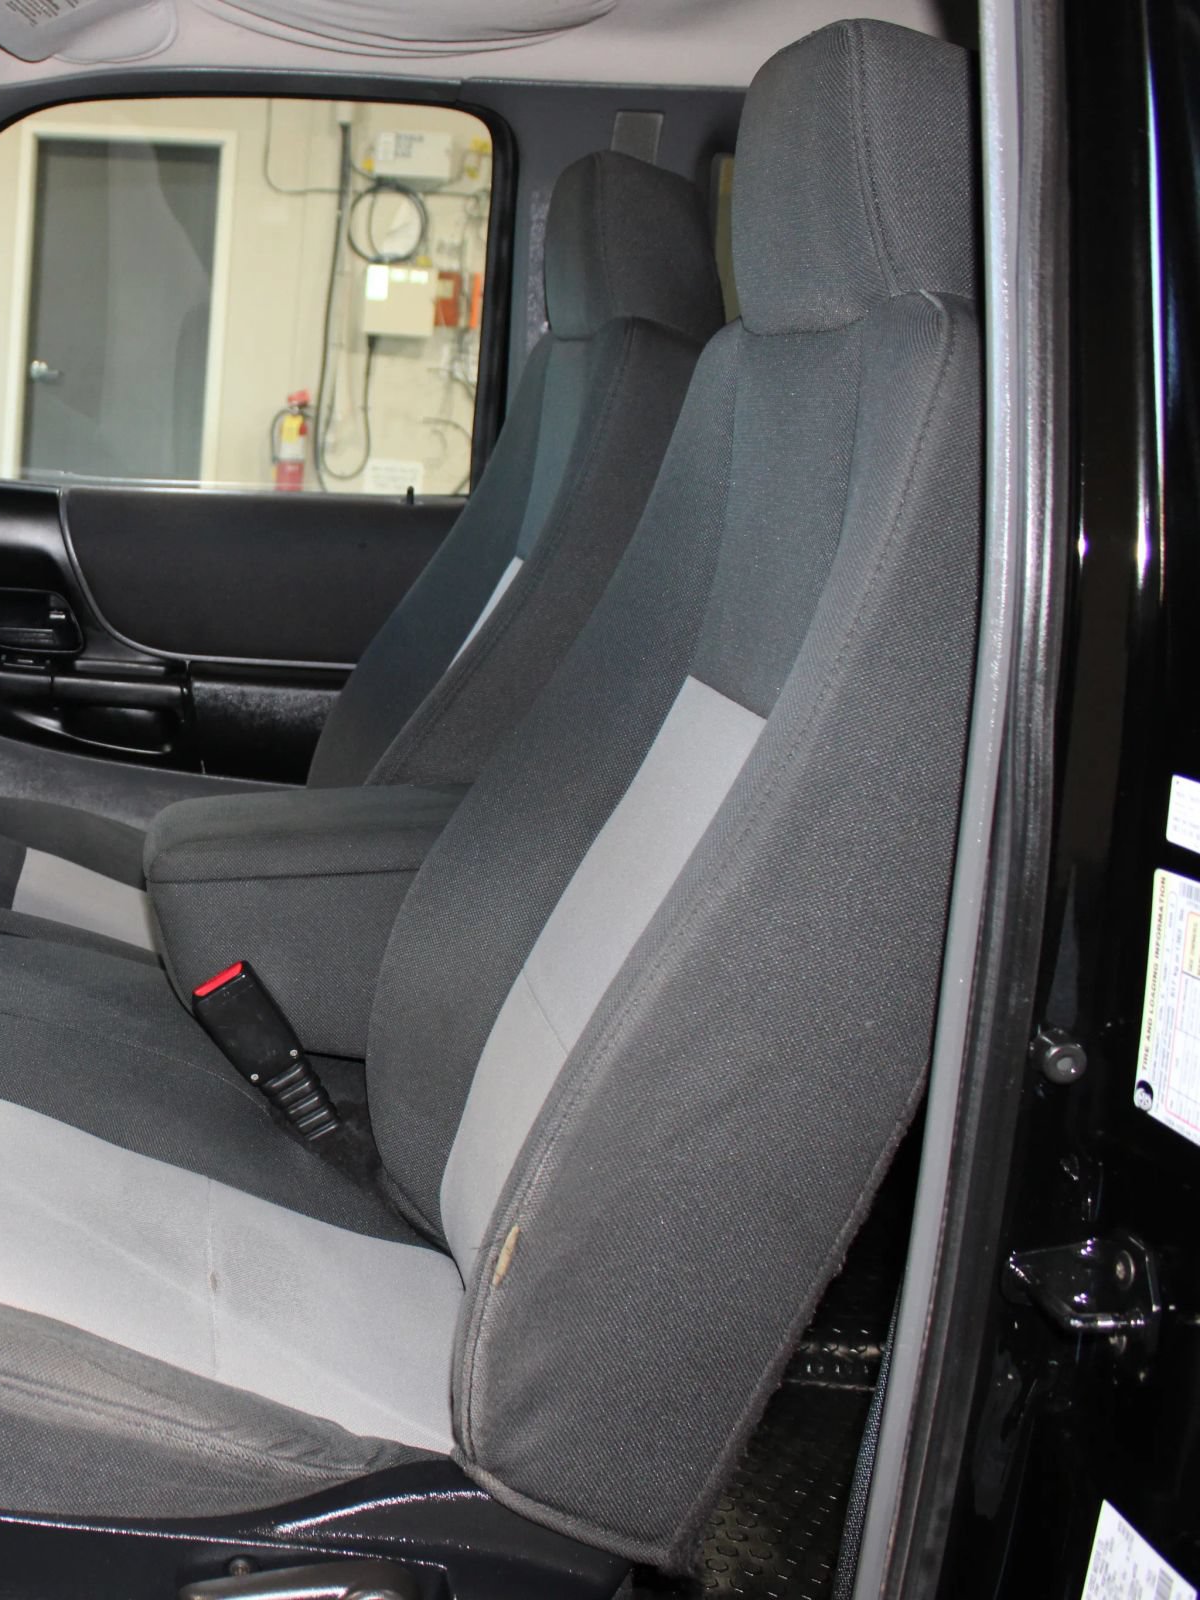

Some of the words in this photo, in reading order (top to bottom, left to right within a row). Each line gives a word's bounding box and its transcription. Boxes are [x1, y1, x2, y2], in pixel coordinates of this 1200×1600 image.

[1154, 876, 1166, 959] INFORMATION
[1149, 962, 1159, 1014] LOADING
[1145, 1017, 1153, 1041] AND
[1141, 1046, 1150, 1071] TIRE
